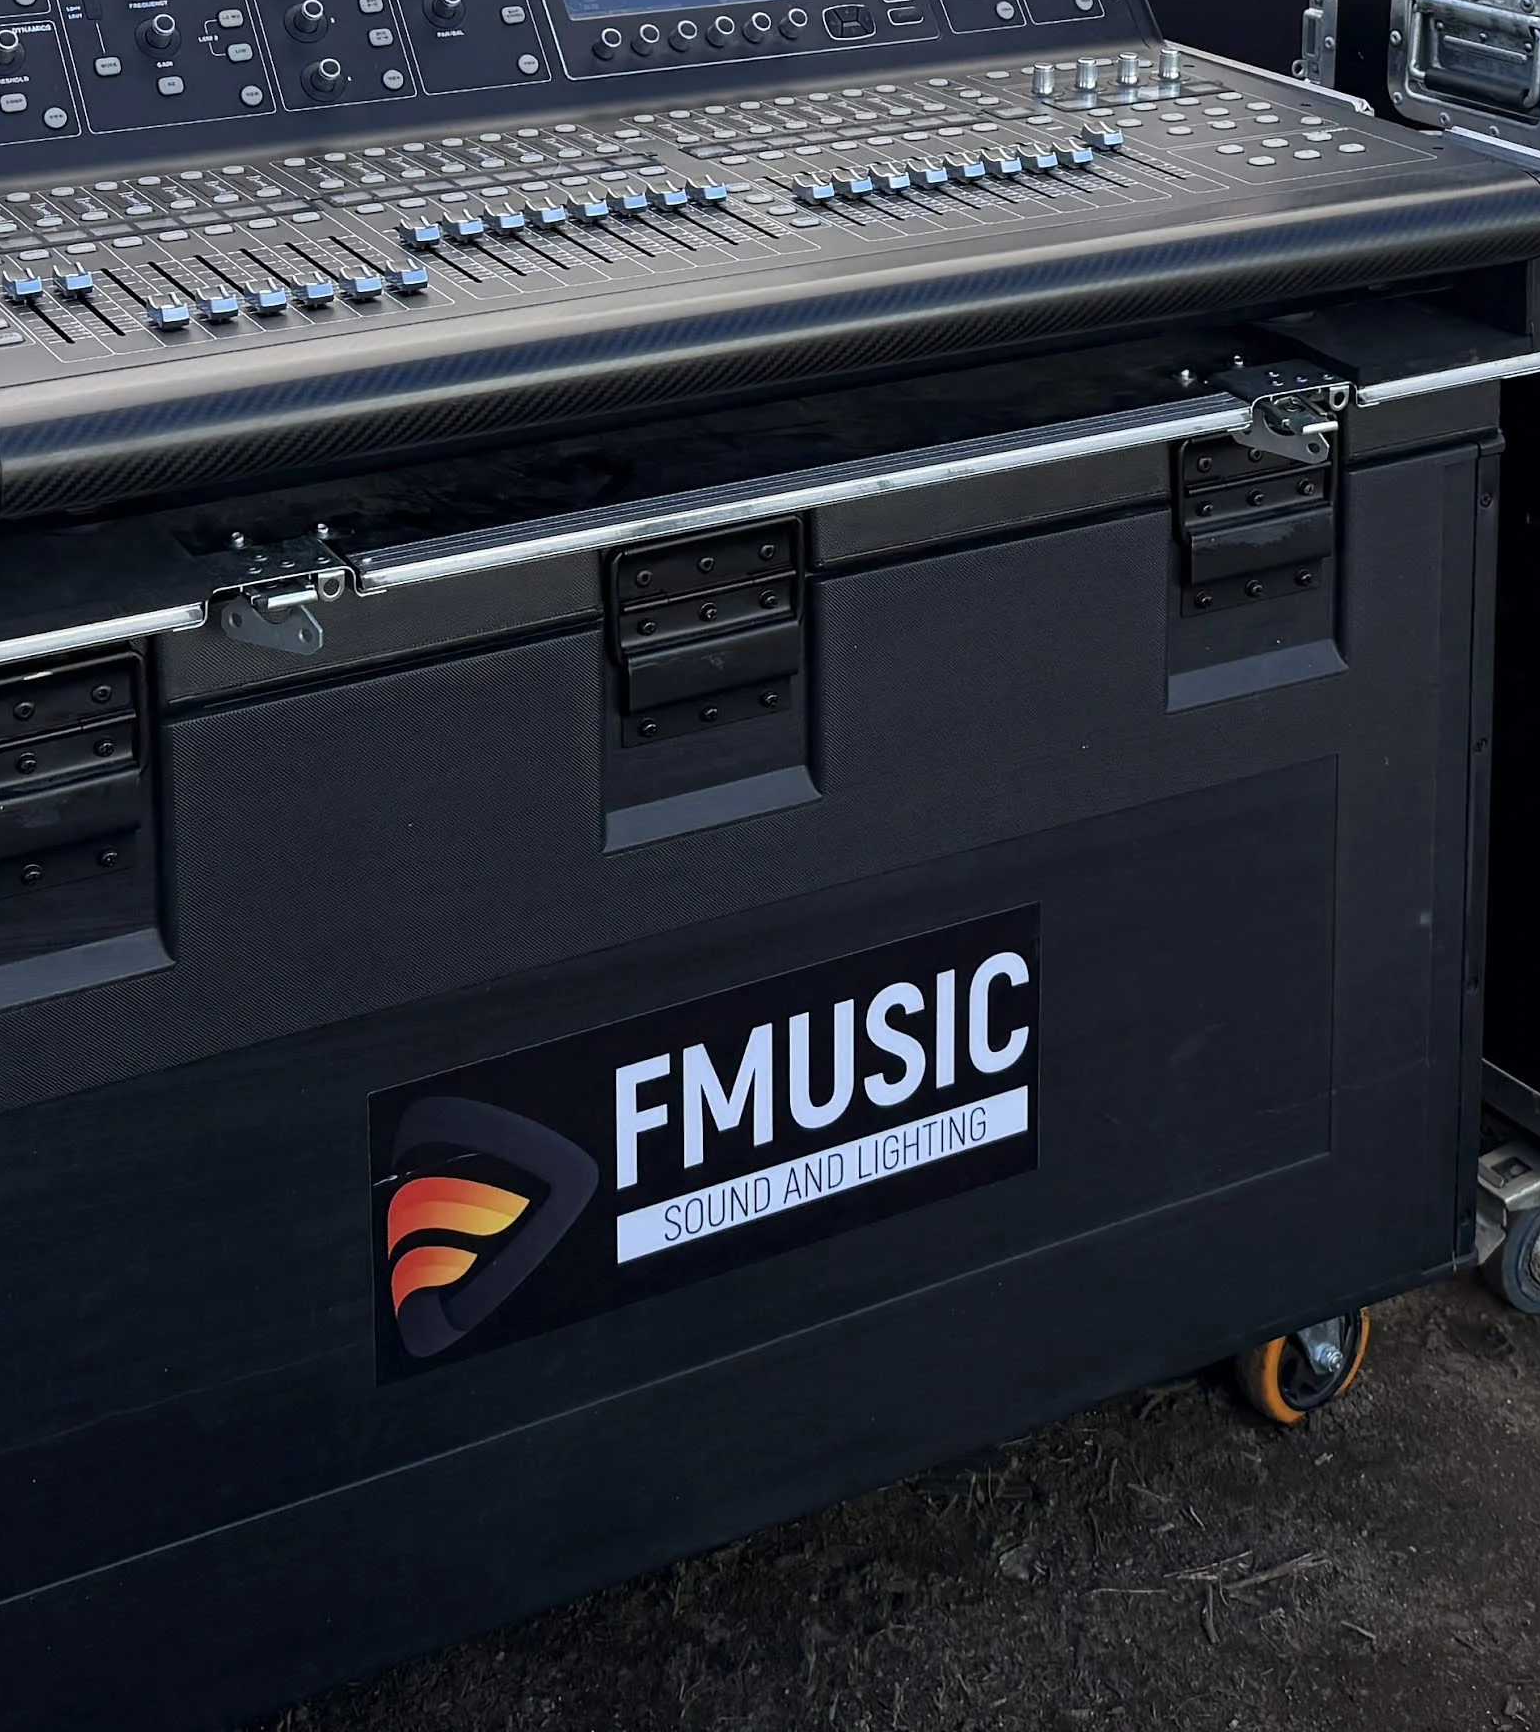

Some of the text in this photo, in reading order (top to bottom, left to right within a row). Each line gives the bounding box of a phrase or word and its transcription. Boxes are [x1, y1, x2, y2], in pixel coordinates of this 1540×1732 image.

[616, 952, 1029, 1191] FMUSIC
[664, 1106, 987, 1242] SOUND AND LIGHTING
